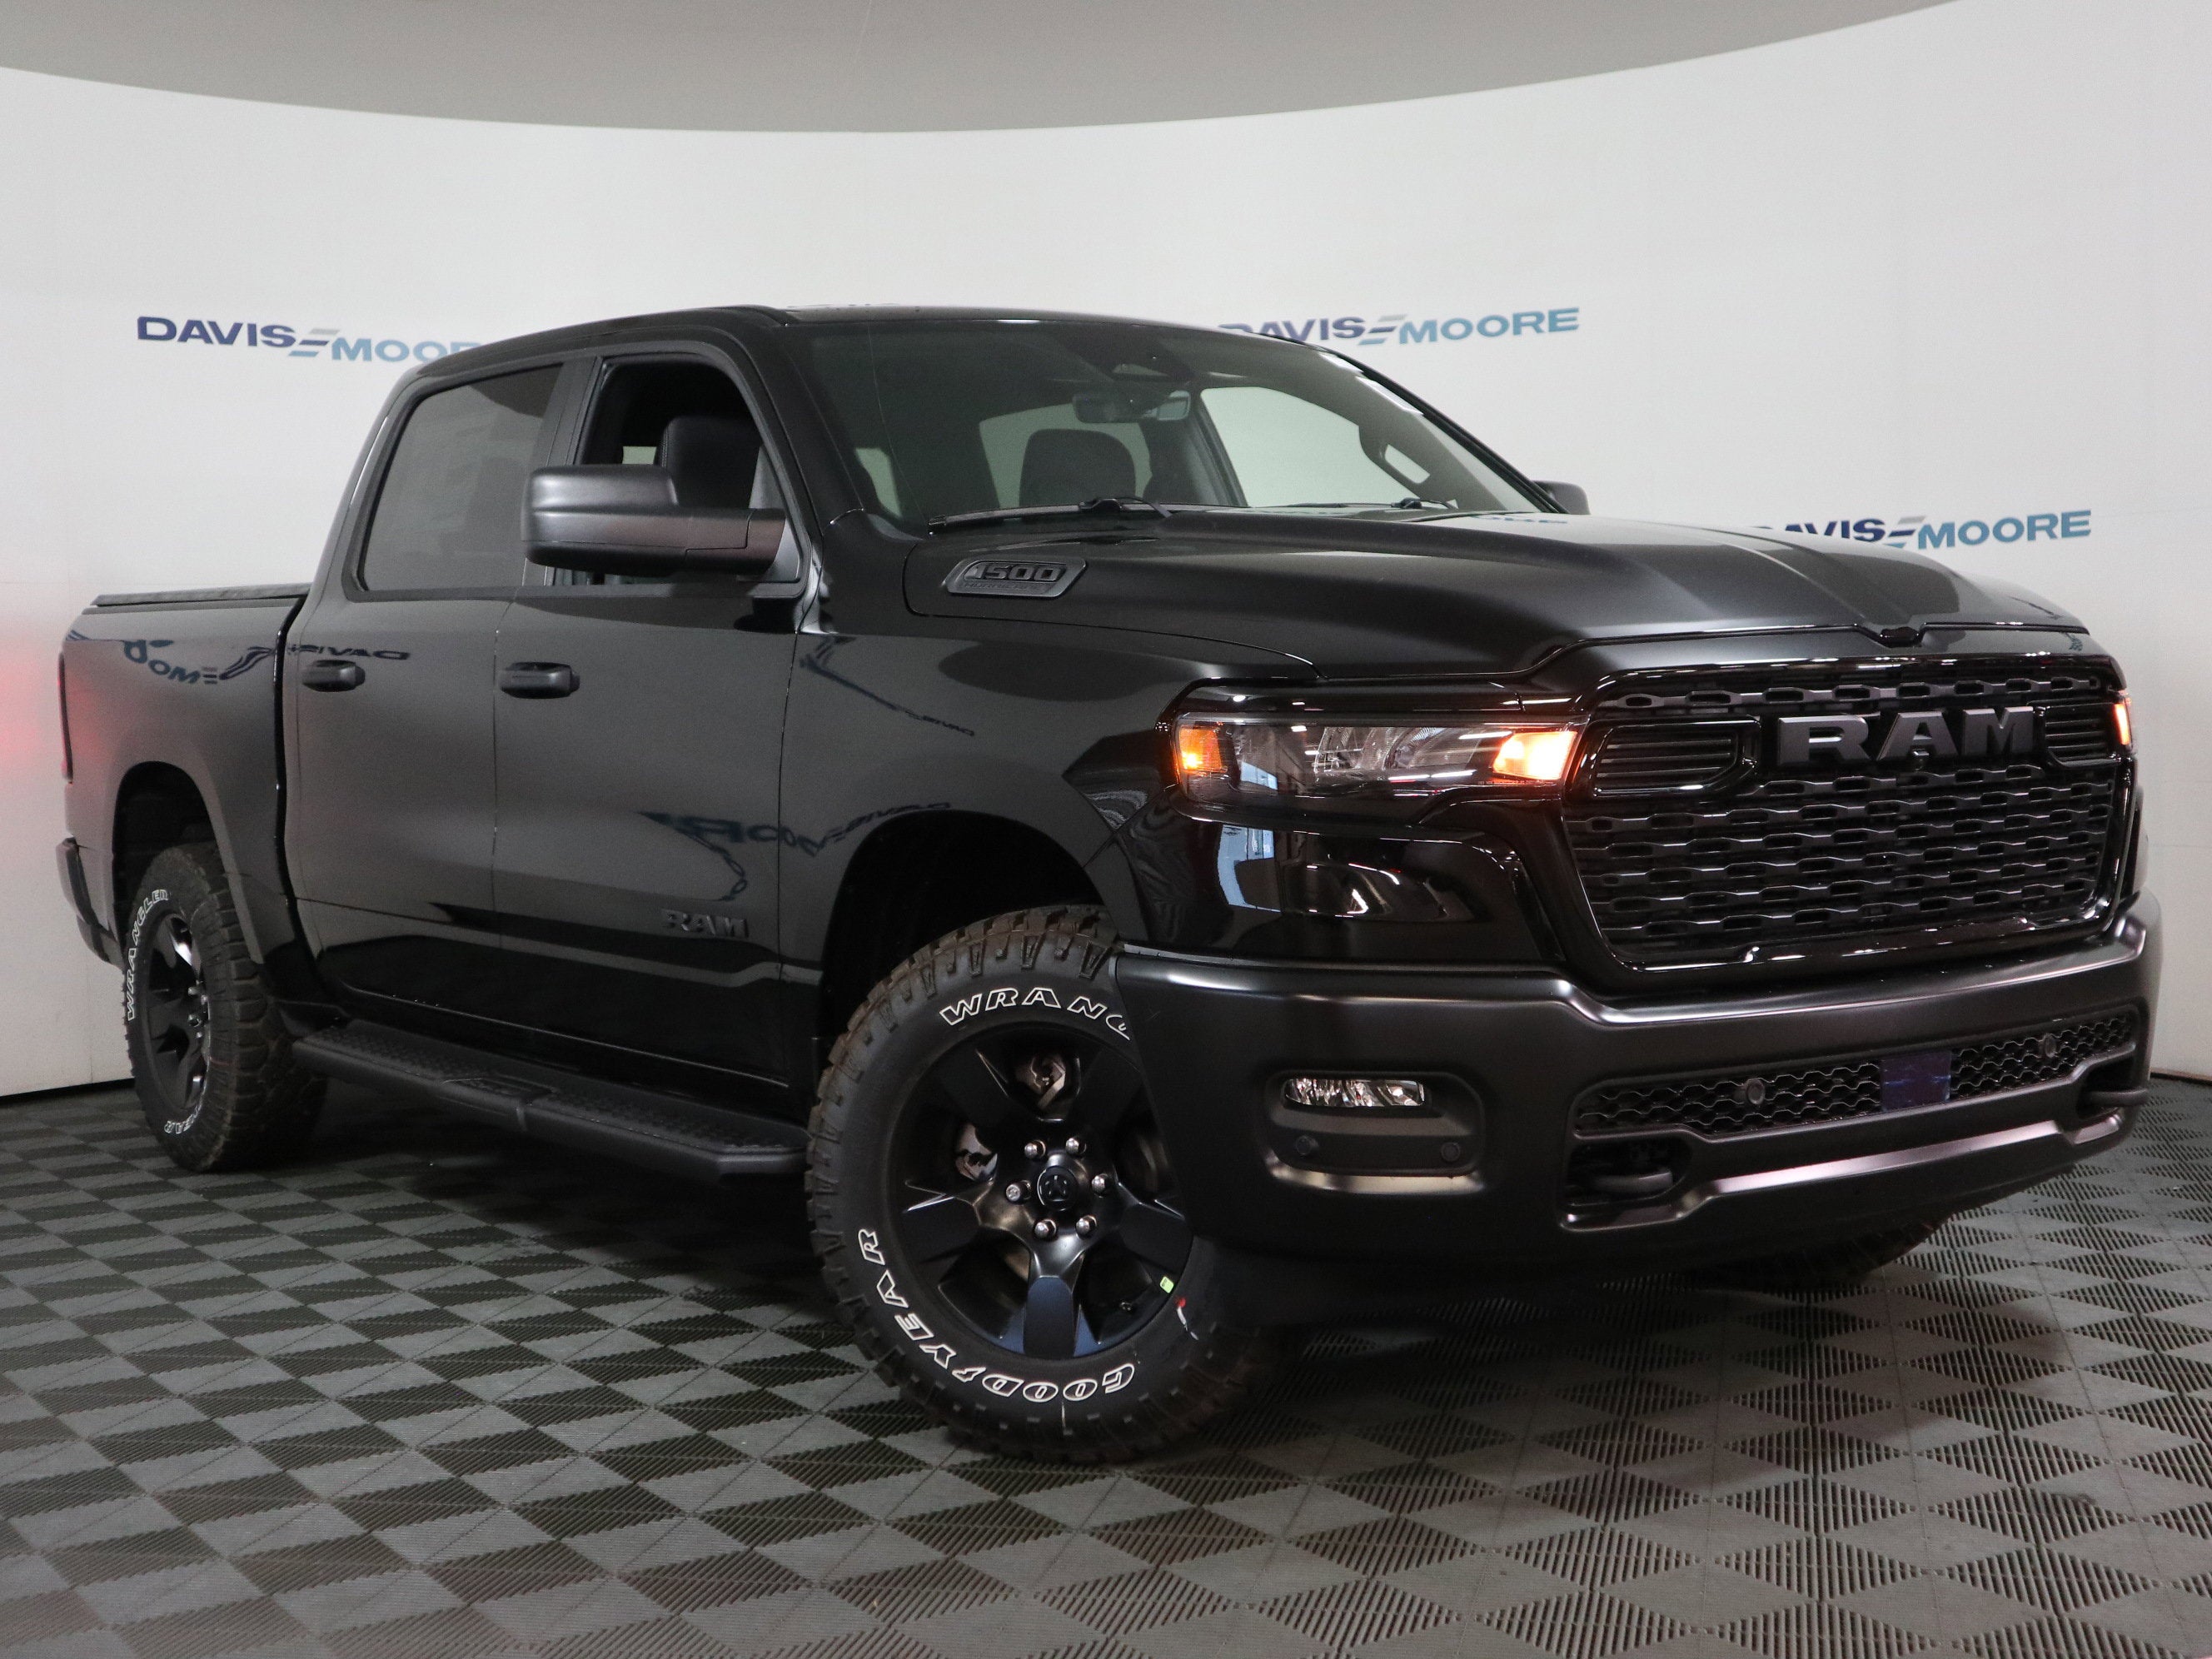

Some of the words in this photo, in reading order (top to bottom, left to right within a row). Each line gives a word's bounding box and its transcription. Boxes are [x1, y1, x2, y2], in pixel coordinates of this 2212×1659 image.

[137, 316, 295, 348] DAVIS
[1398, 307, 1579, 344] MOORE
[1918, 510, 2091, 550] MOORE
[973, 563, 1062, 581] 1500
[1779, 706, 2035, 766] RAM
[660, 909, 749, 939] RAM
[858, 1228, 1134, 1402] GOODYEAR
